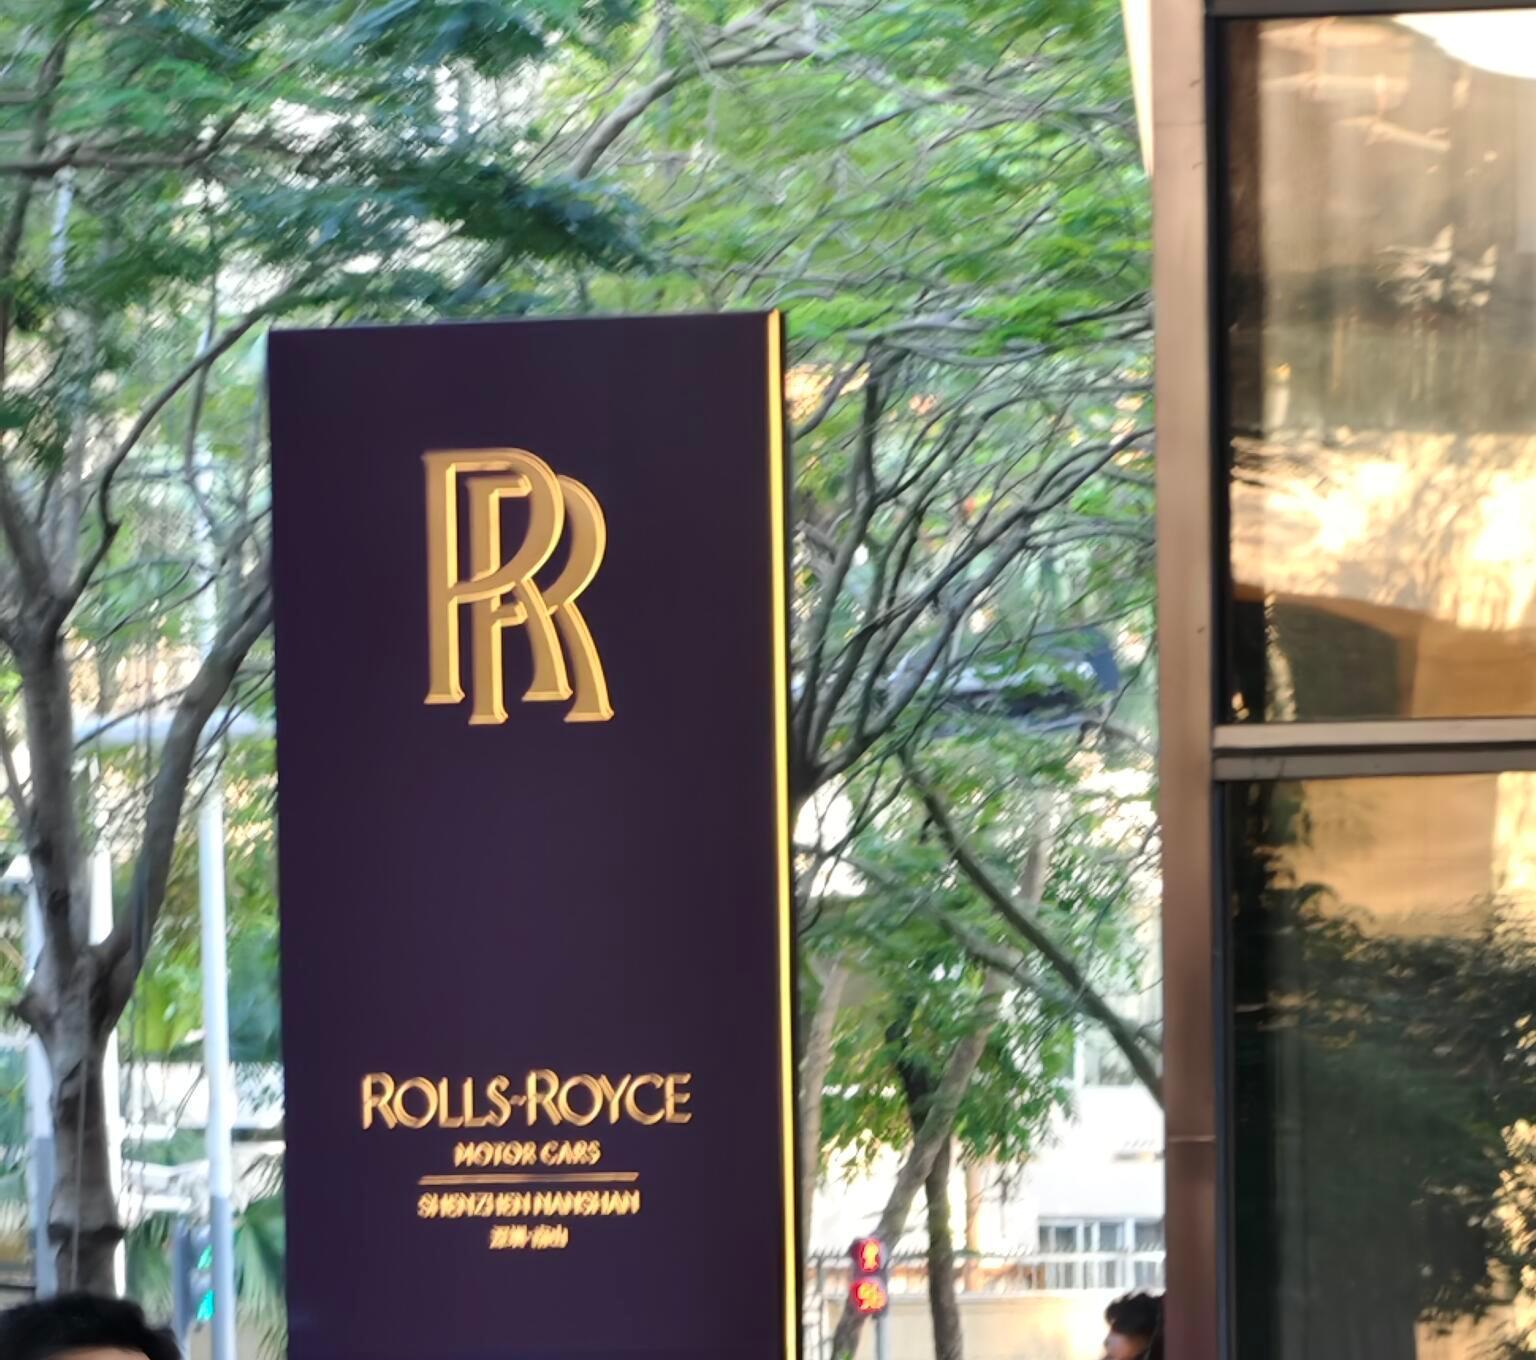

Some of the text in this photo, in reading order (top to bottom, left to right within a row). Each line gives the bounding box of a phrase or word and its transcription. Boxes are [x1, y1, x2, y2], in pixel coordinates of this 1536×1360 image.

[422, 448, 614, 725] RR
[361, 1069, 693, 1129] ROLLS-ROYCE
[453, 1140, 601, 1166] MOTOR CARS
[417, 1190, 640, 1218] SHENZHEN NANSHAN
